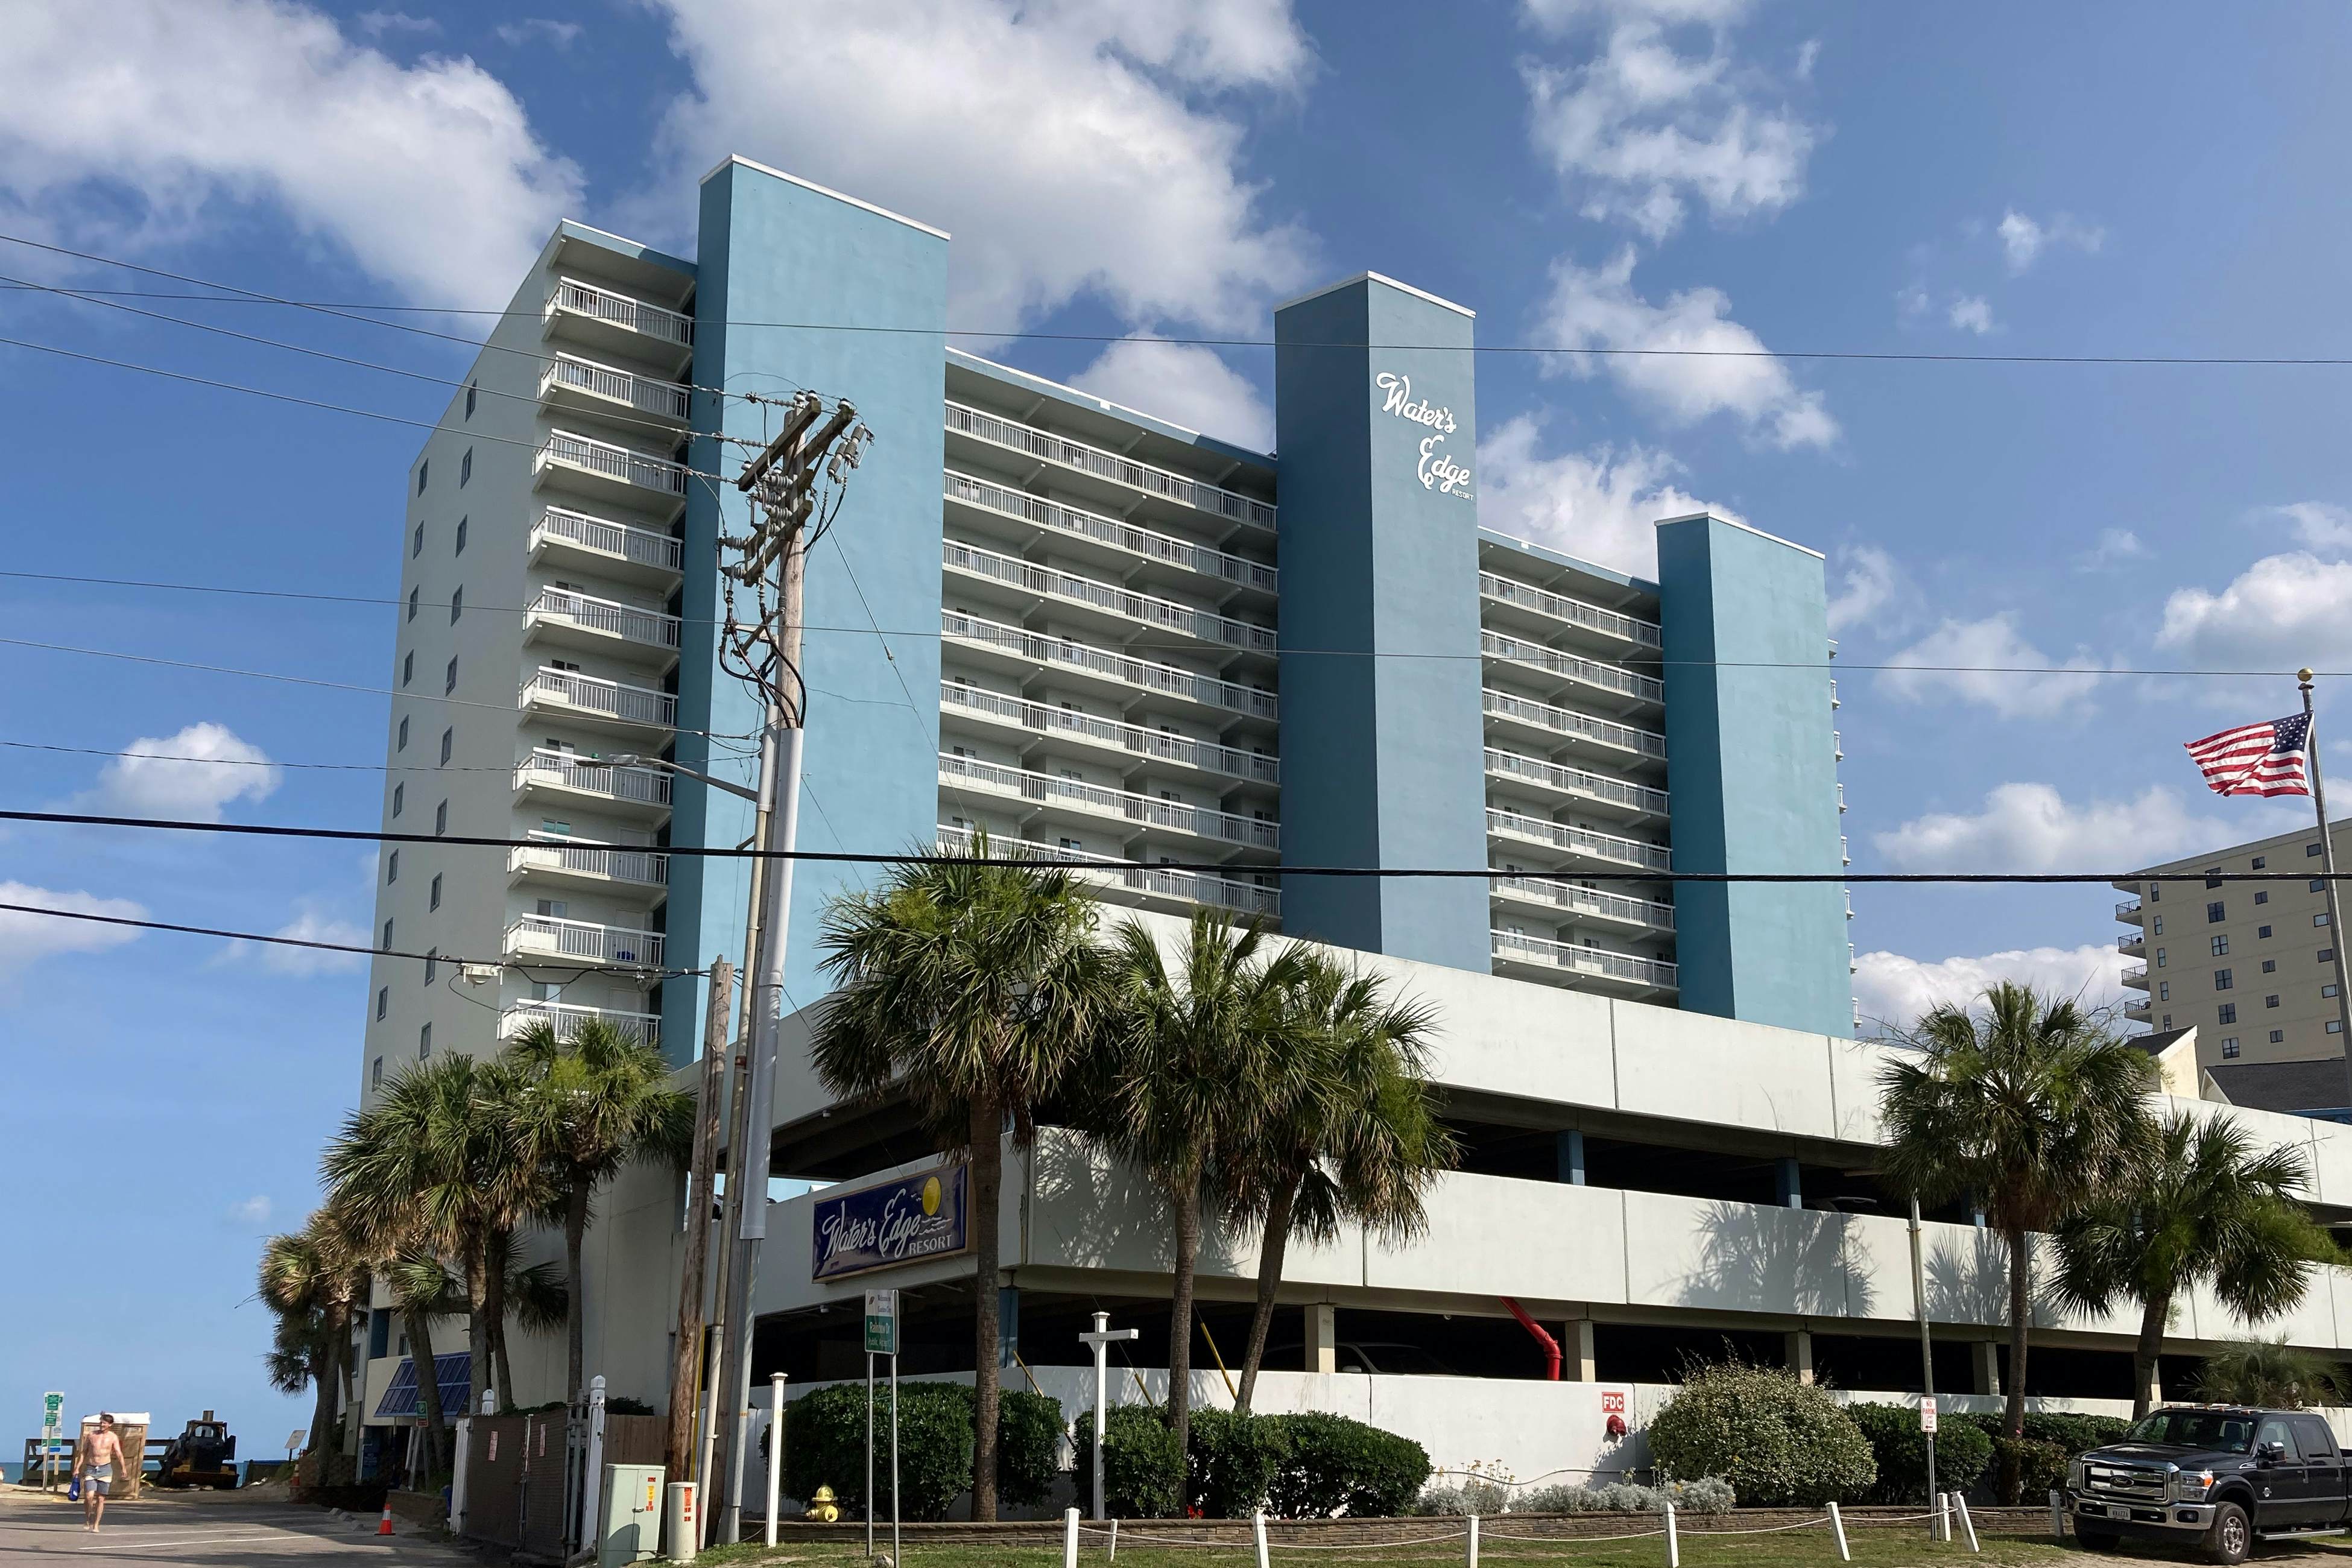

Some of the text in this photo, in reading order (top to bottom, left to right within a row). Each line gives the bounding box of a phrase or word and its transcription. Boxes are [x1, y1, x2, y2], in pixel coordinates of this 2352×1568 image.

[1376, 372, 1457, 434] Water's
[1417, 434, 1470, 493] Edge
[1452, 488, 1474, 501] RESORT
[822, 1188, 921, 1260] Water's Edge
[909, 1235, 952, 1255] RESORT
[1604, 1396, 1623, 1409] FDC
